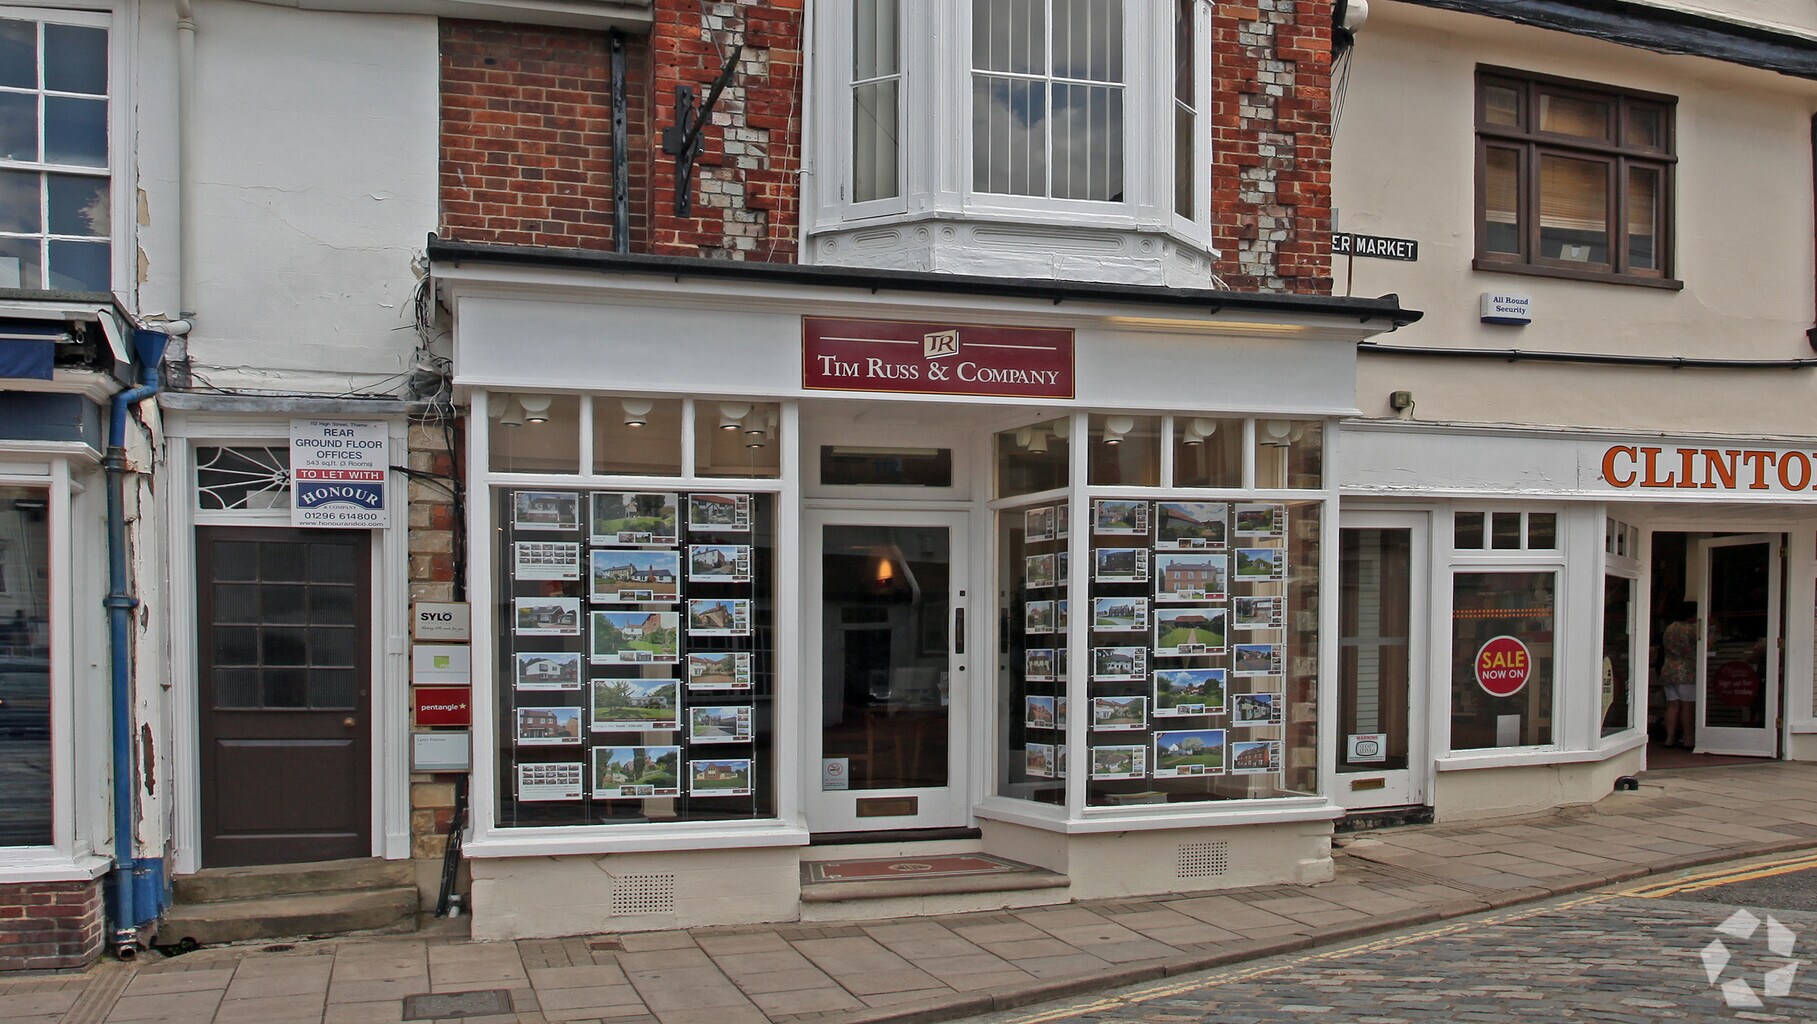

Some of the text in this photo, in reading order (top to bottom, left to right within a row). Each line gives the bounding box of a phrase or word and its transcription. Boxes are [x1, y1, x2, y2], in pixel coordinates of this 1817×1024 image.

[1356, 238, 1414, 258] MARKET
[1493, 296, 1528, 305] All Round
[1495, 305, 1526, 315] Security
[926, 334, 955, 352] TR
[927, 361, 949, 381] &
[323, 428, 354, 437] REAR
[295, 438, 383, 449] GROUND FLOOR
[316, 450, 363, 460] OFFICES
[301, 470, 379, 480] TO LET WITH
[301, 487, 379, 505] HONOUR
[339, 513, 377, 521] 614800
[1482, 650, 1525, 669] SALE
[1482, 669, 1524, 679] NOW ON
